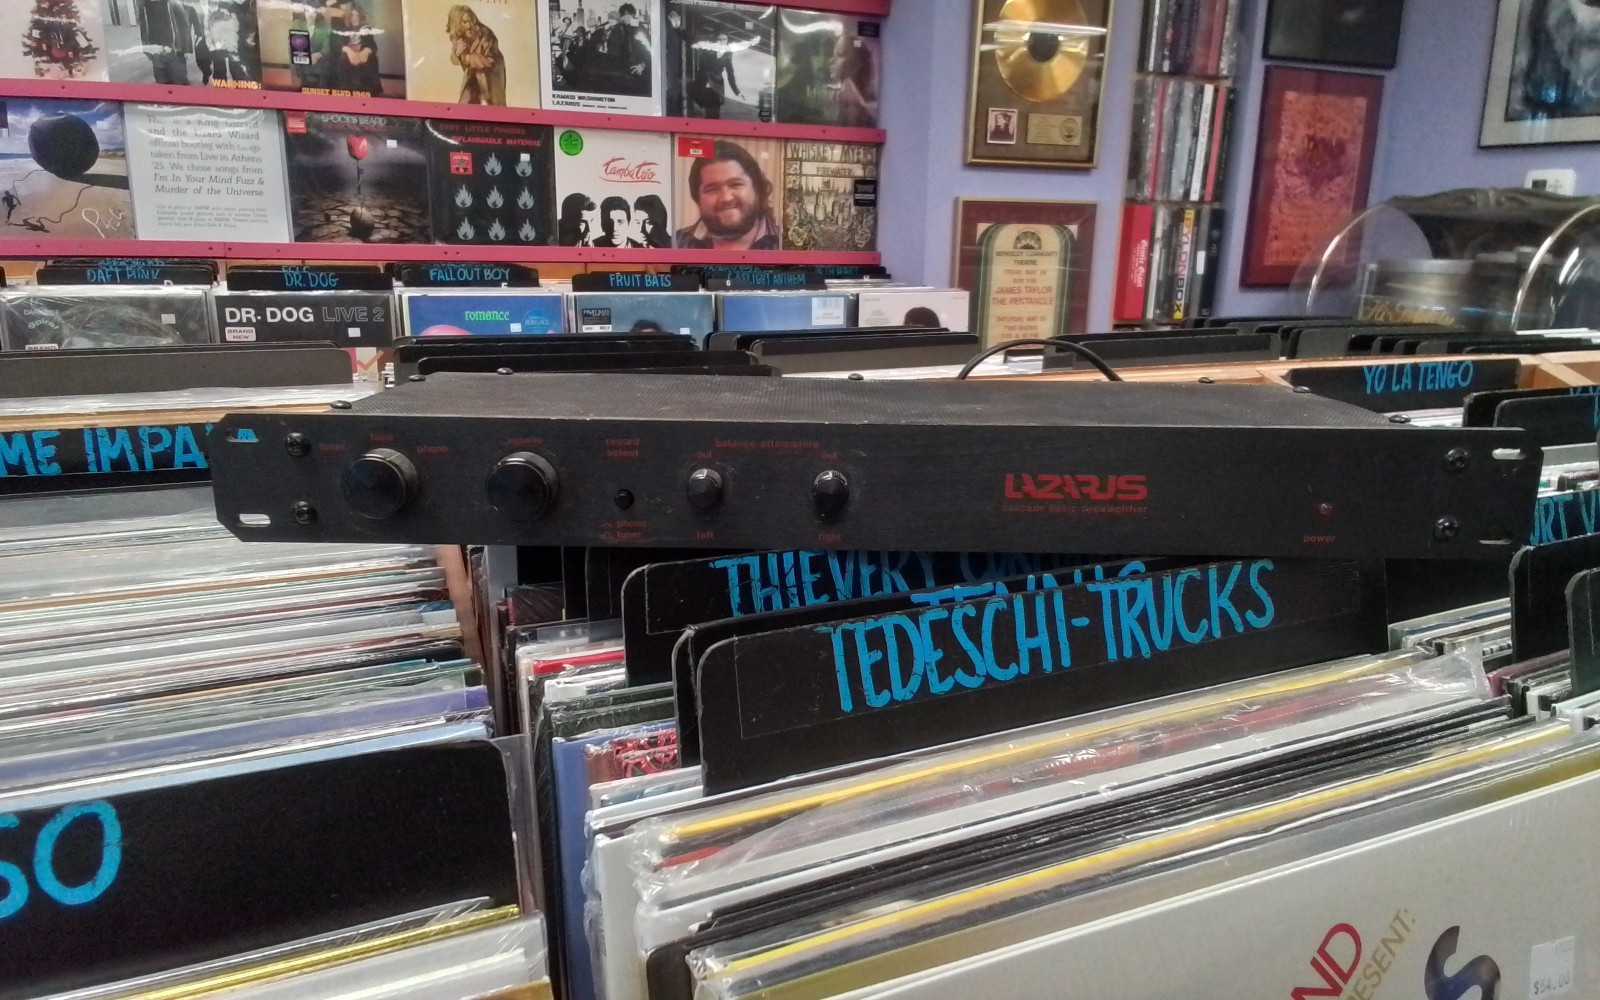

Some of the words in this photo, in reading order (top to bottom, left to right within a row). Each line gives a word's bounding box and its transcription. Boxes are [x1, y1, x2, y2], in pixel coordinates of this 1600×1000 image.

[212, 79, 262, 89] WARNING:
[302, 87, 330, 95] SUNSET
[331, 89, 351, 97] BLVD
[359, 115, 387, 126] BEARD
[147, 127, 166, 136] and
[172, 128, 188, 137] the
[228, 131, 260, 140] Wizard
[149, 140, 179, 148] official
[181, 141, 214, 151] bootleg
[215, 142, 236, 150] with
[506, 139, 541, 147] MATERIAL
[150, 151, 175, 159] taken
[176, 151, 199, 160] from
[200, 152, 218, 161] Live
[220, 153, 229, 161] in
[231, 154, 263, 163] Athens
[789, 143, 836, 161] WHISKEY
[169, 162, 184, 171] We
[186, 163, 212, 172] chose
[215, 166, 240, 175] songs
[242, 165, 264, 174] from
[153, 172, 168, 181] I'm
[172, 173, 181, 182] In
[185, 174, 206, 183] Your
[208, 175, 233, 184] Mind
[235, 176, 255, 185] Fuzz
[257, 177, 265, 185] &
[155, 185, 189, 194] Murder
[193, 185, 202, 194] of
[207, 186, 222, 195] the
[86, 268, 121, 283] DAFT
[126, 267, 160, 280] PUNK
[284, 272, 306, 287] DR.
[308, 272, 340, 287] DOG
[484, 267, 510, 281] BOY
[773, 273, 806, 285] ANTHEM
[163, 279, 174, 287] D
[609, 274, 642, 287] FRUIT
[644, 274, 672, 287] BATS
[994, 286, 1021, 295] JAMES
[1024, 286, 1053, 295] TAYLOR
[992, 297, 1007, 305] THE
[1009, 297, 1056, 305] PENTANGLE
[266, 306, 315, 323] DOG
[322, 306, 369, 322] LIVE
[372, 307, 385, 322] 2
[464, 310, 510, 321] romance
[28, 318, 59, 330] Spiral
[1363, 365, 1388, 395] YO
[1391, 363, 1412, 392] LA
[1418, 361, 1474, 392] TENGO
[83, 424, 213, 473] IMPA
[605, 437, 640, 446] record
[715, 439, 756, 449] balance
[760, 440, 819, 449] attenuators
[416, 444, 448, 455] phono
[607, 449, 639, 457] select
[1005, 472, 1148, 500] LAZARUS
[616, 520, 648, 529] phono
[616, 530, 642, 539] tuner
[696, 530, 715, 540] left
[818, 532, 841, 543] right
[1303, 535, 1337, 544] power
[709, 550, 935, 619] THIEVERY
[815, 559, 1275, 713] TEDESCHI-TRUCKS
[1346, 908, 1417, 1000] ESENT:
